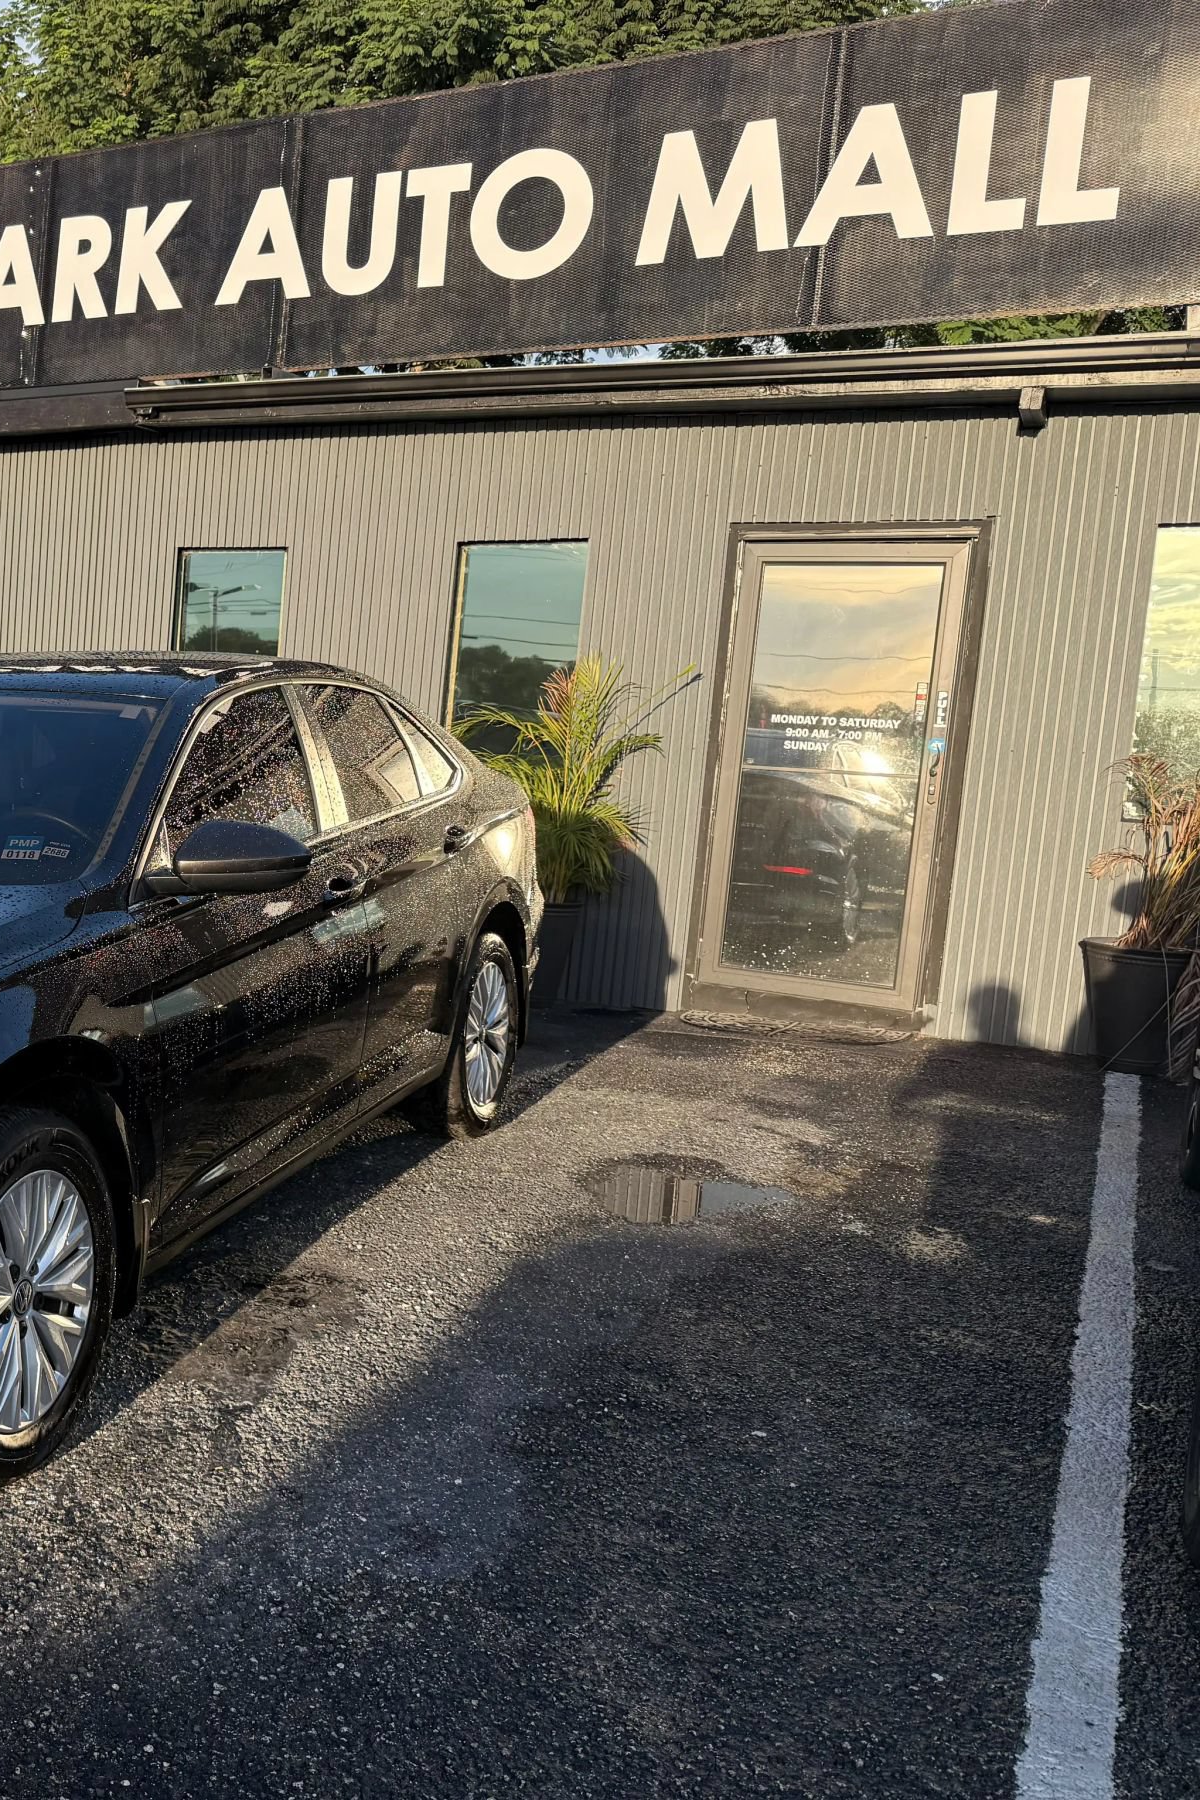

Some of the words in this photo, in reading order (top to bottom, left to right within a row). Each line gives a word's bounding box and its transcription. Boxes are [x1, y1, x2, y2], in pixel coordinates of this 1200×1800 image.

[214, 147, 595, 306] AUTO
[634, 76, 1120, 267] MALL
[936, 691, 948, 728] PULL
[770, 714, 819, 726] MONDAY
[821, 716, 837, 726] TO
[839, 717, 901, 729] SATURDAY
[785, 727, 809, 737] 9:00
[811, 729, 829, 738] AM
[838, 730, 862, 740] 7:00
[783, 740, 830, 752] SUNDAY
[9, 839, 40, 847] PMP
[6, 850, 36, 859] 0118
